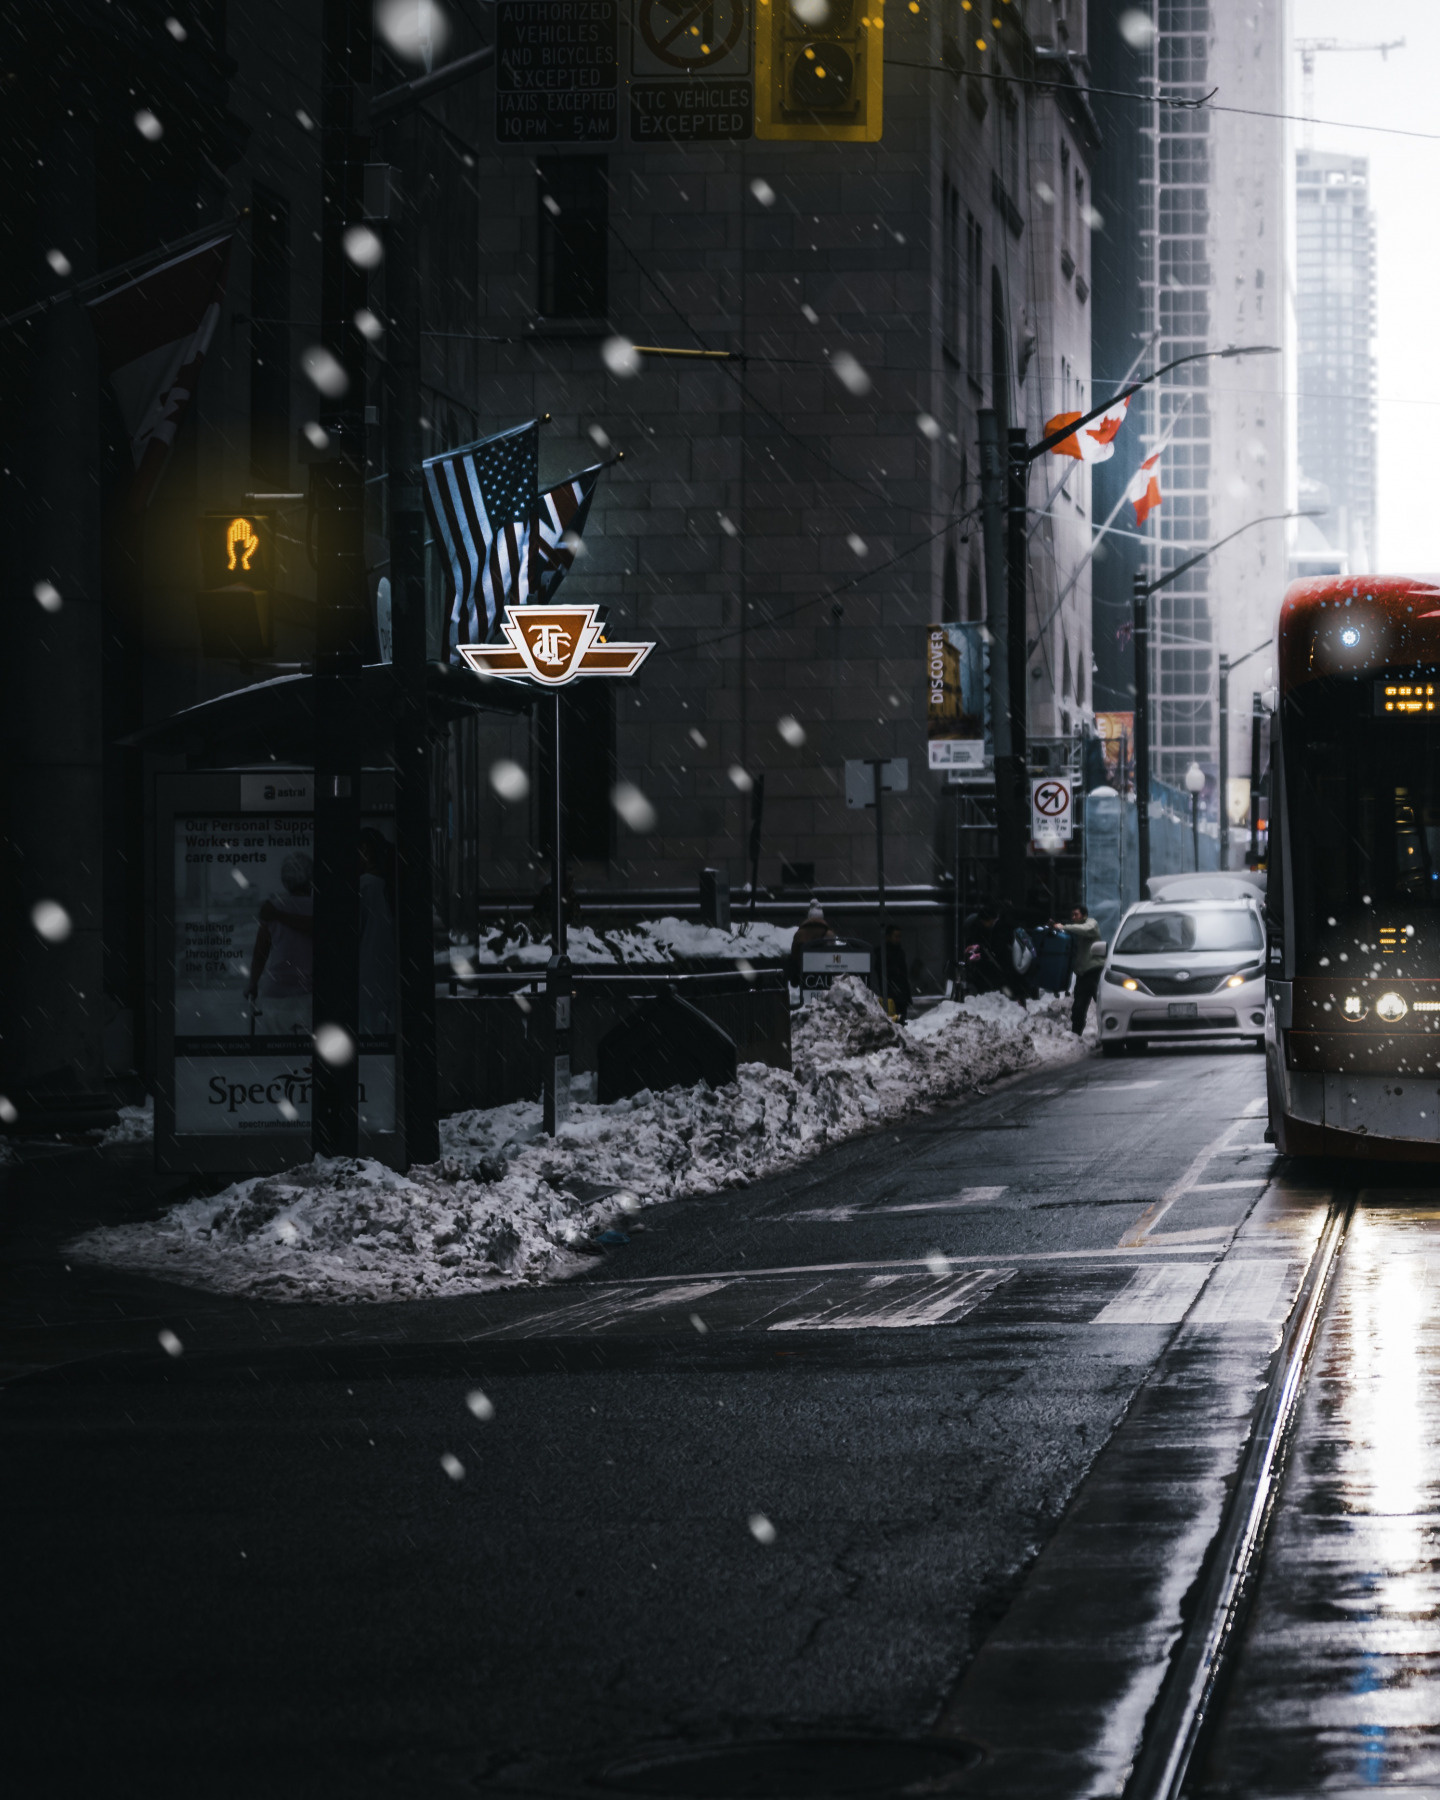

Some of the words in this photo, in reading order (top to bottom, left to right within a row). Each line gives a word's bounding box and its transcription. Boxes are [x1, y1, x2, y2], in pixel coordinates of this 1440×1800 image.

[503, 3, 611, 22] AUTHORIZED
[515, 25, 599, 43] VEHICLES
[501, 48, 532, 65] AND
[543, 46, 614, 65] BICYCLES
[513, 68, 600, 88] EXCEPTED
[499, 93, 537, 112] TAXIS
[548, 92, 615, 111] EXCEPTED
[634, 91, 666, 109] TTC
[675, 89, 749, 108] VEHICLES
[504, 117, 522, 136] 10
[525, 119, 547, 135] PM
[573, 116, 583, 134] 5
[587, 118, 610, 134] AM
[640, 114, 744, 134] EXCEPTED
[930, 631, 944, 704] DISCOVER
[277, 787, 306, 798] astral
[185, 820, 209, 832] Our
[212, 820, 270, 832] Personal
[274, 820, 315, 834] Suppo
[185, 835, 239, 847] Workers
[243, 837, 263, 847] are
[268, 834, 310, 847] health
[185, 854, 213, 863] care
[217, 852, 267, 865] experts
[185, 922, 234, 933] Positions
[185, 935, 232, 945] available
[185, 949, 243, 961] throughout
[185, 962, 201, 971] the
[204, 962, 227, 972] GTA
[238, 1118, 311, 1130] spectrumhealthca
